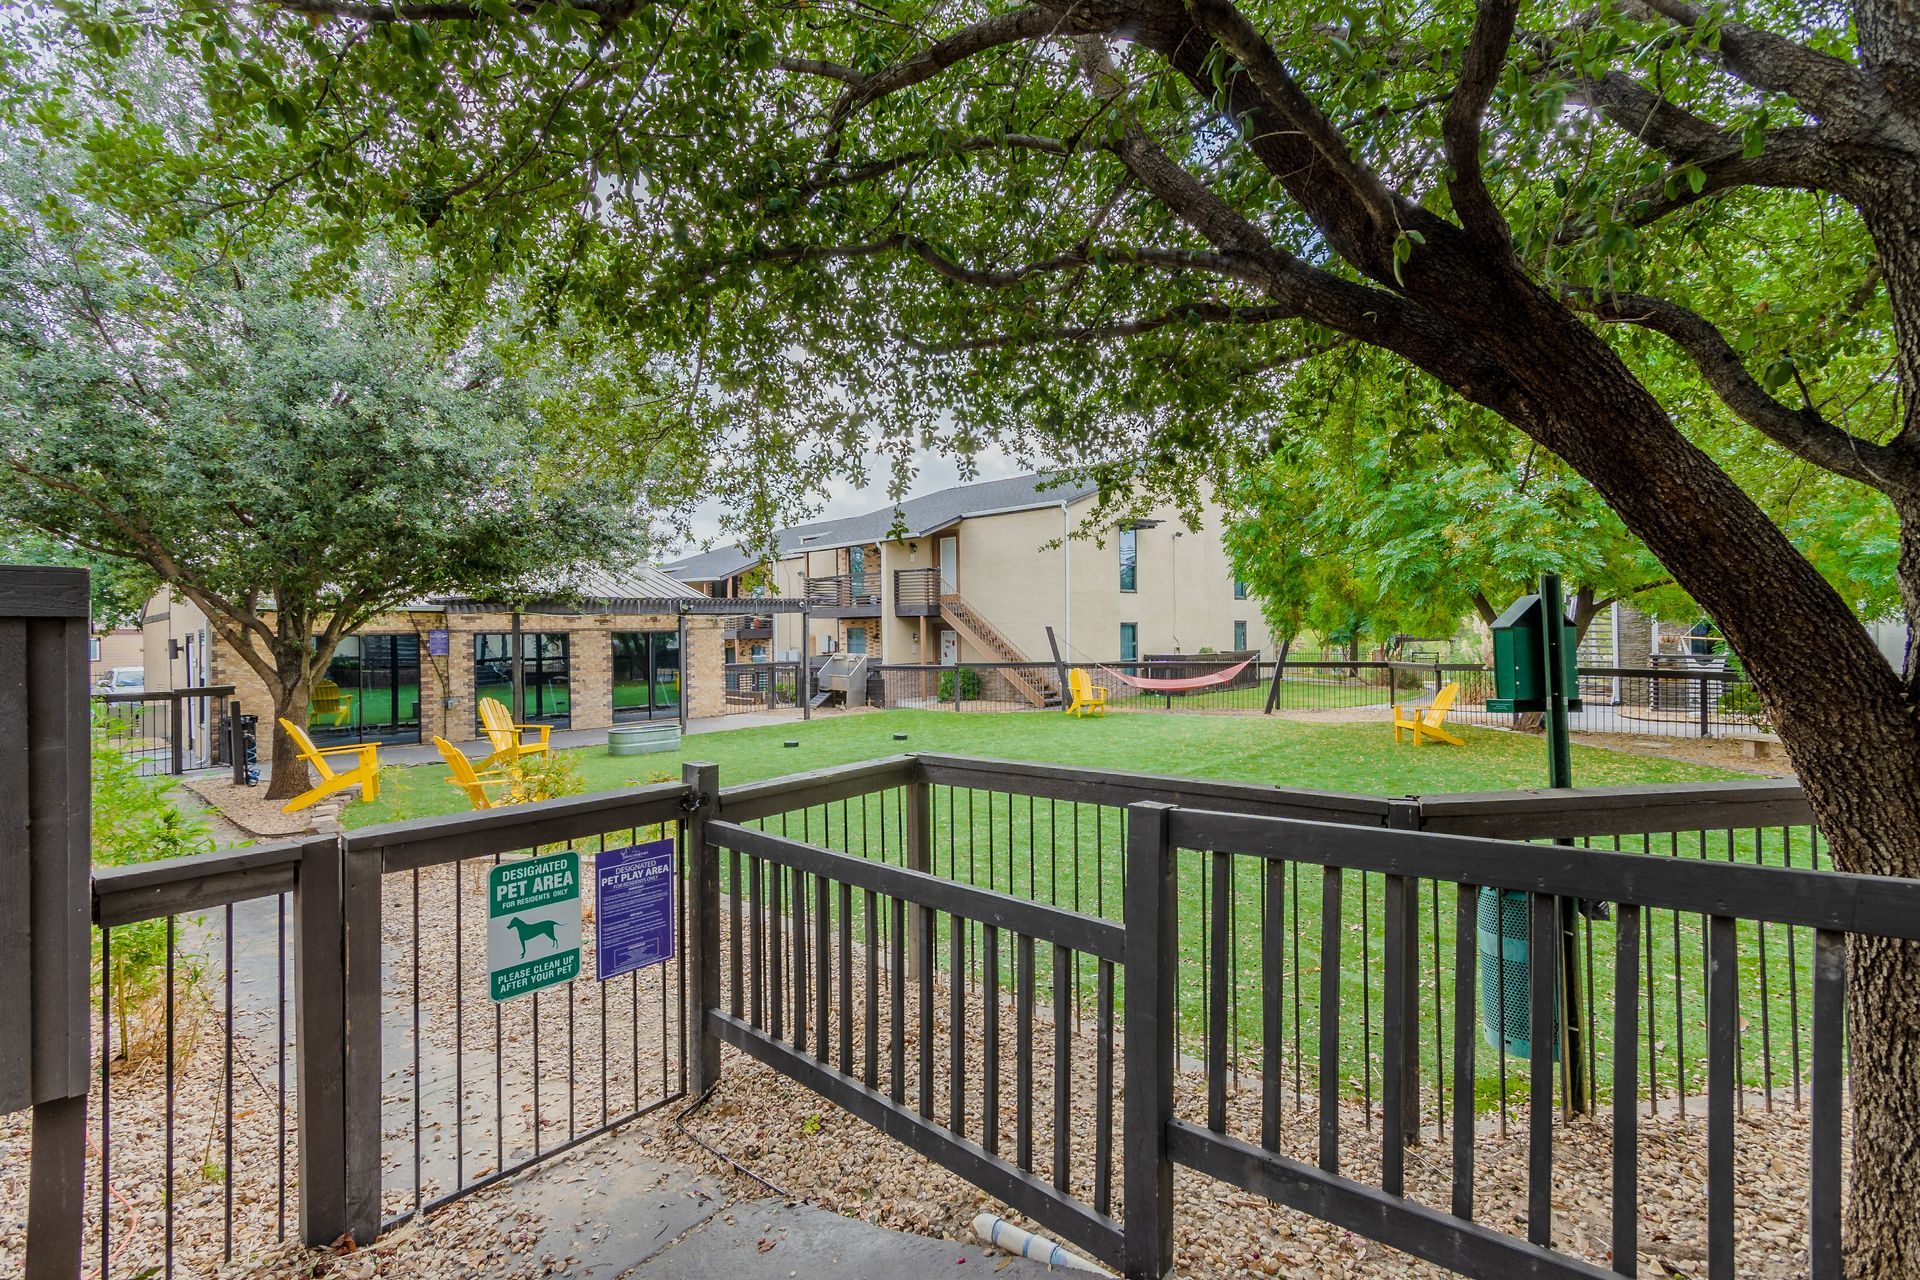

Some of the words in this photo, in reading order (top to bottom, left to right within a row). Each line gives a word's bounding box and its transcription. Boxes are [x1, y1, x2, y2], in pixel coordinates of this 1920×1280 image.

[502, 859, 567, 882] DESIGNATED
[602, 875, 619, 886] PET
[621, 870, 643, 882] PLAY
[646, 865, 669, 876] AREA
[616, 860, 656, 874] DESIGNATED
[497, 882, 527, 901] PET
[533, 871, 573, 893] AREA
[623, 878, 646, 887] RESIDENTS
[502, 900, 515, 909] FOR
[516, 893, 550, 906] RESIDENTS
[553, 889, 568, 898] ONLY
[498, 967, 531, 985] PLEASE
[533, 960, 560, 974] CLEAN
[563, 955, 574, 965] UP
[500, 978, 528, 993] AFTER
[531, 971, 554, 984] YOUR
[557, 965, 572, 976] PET
